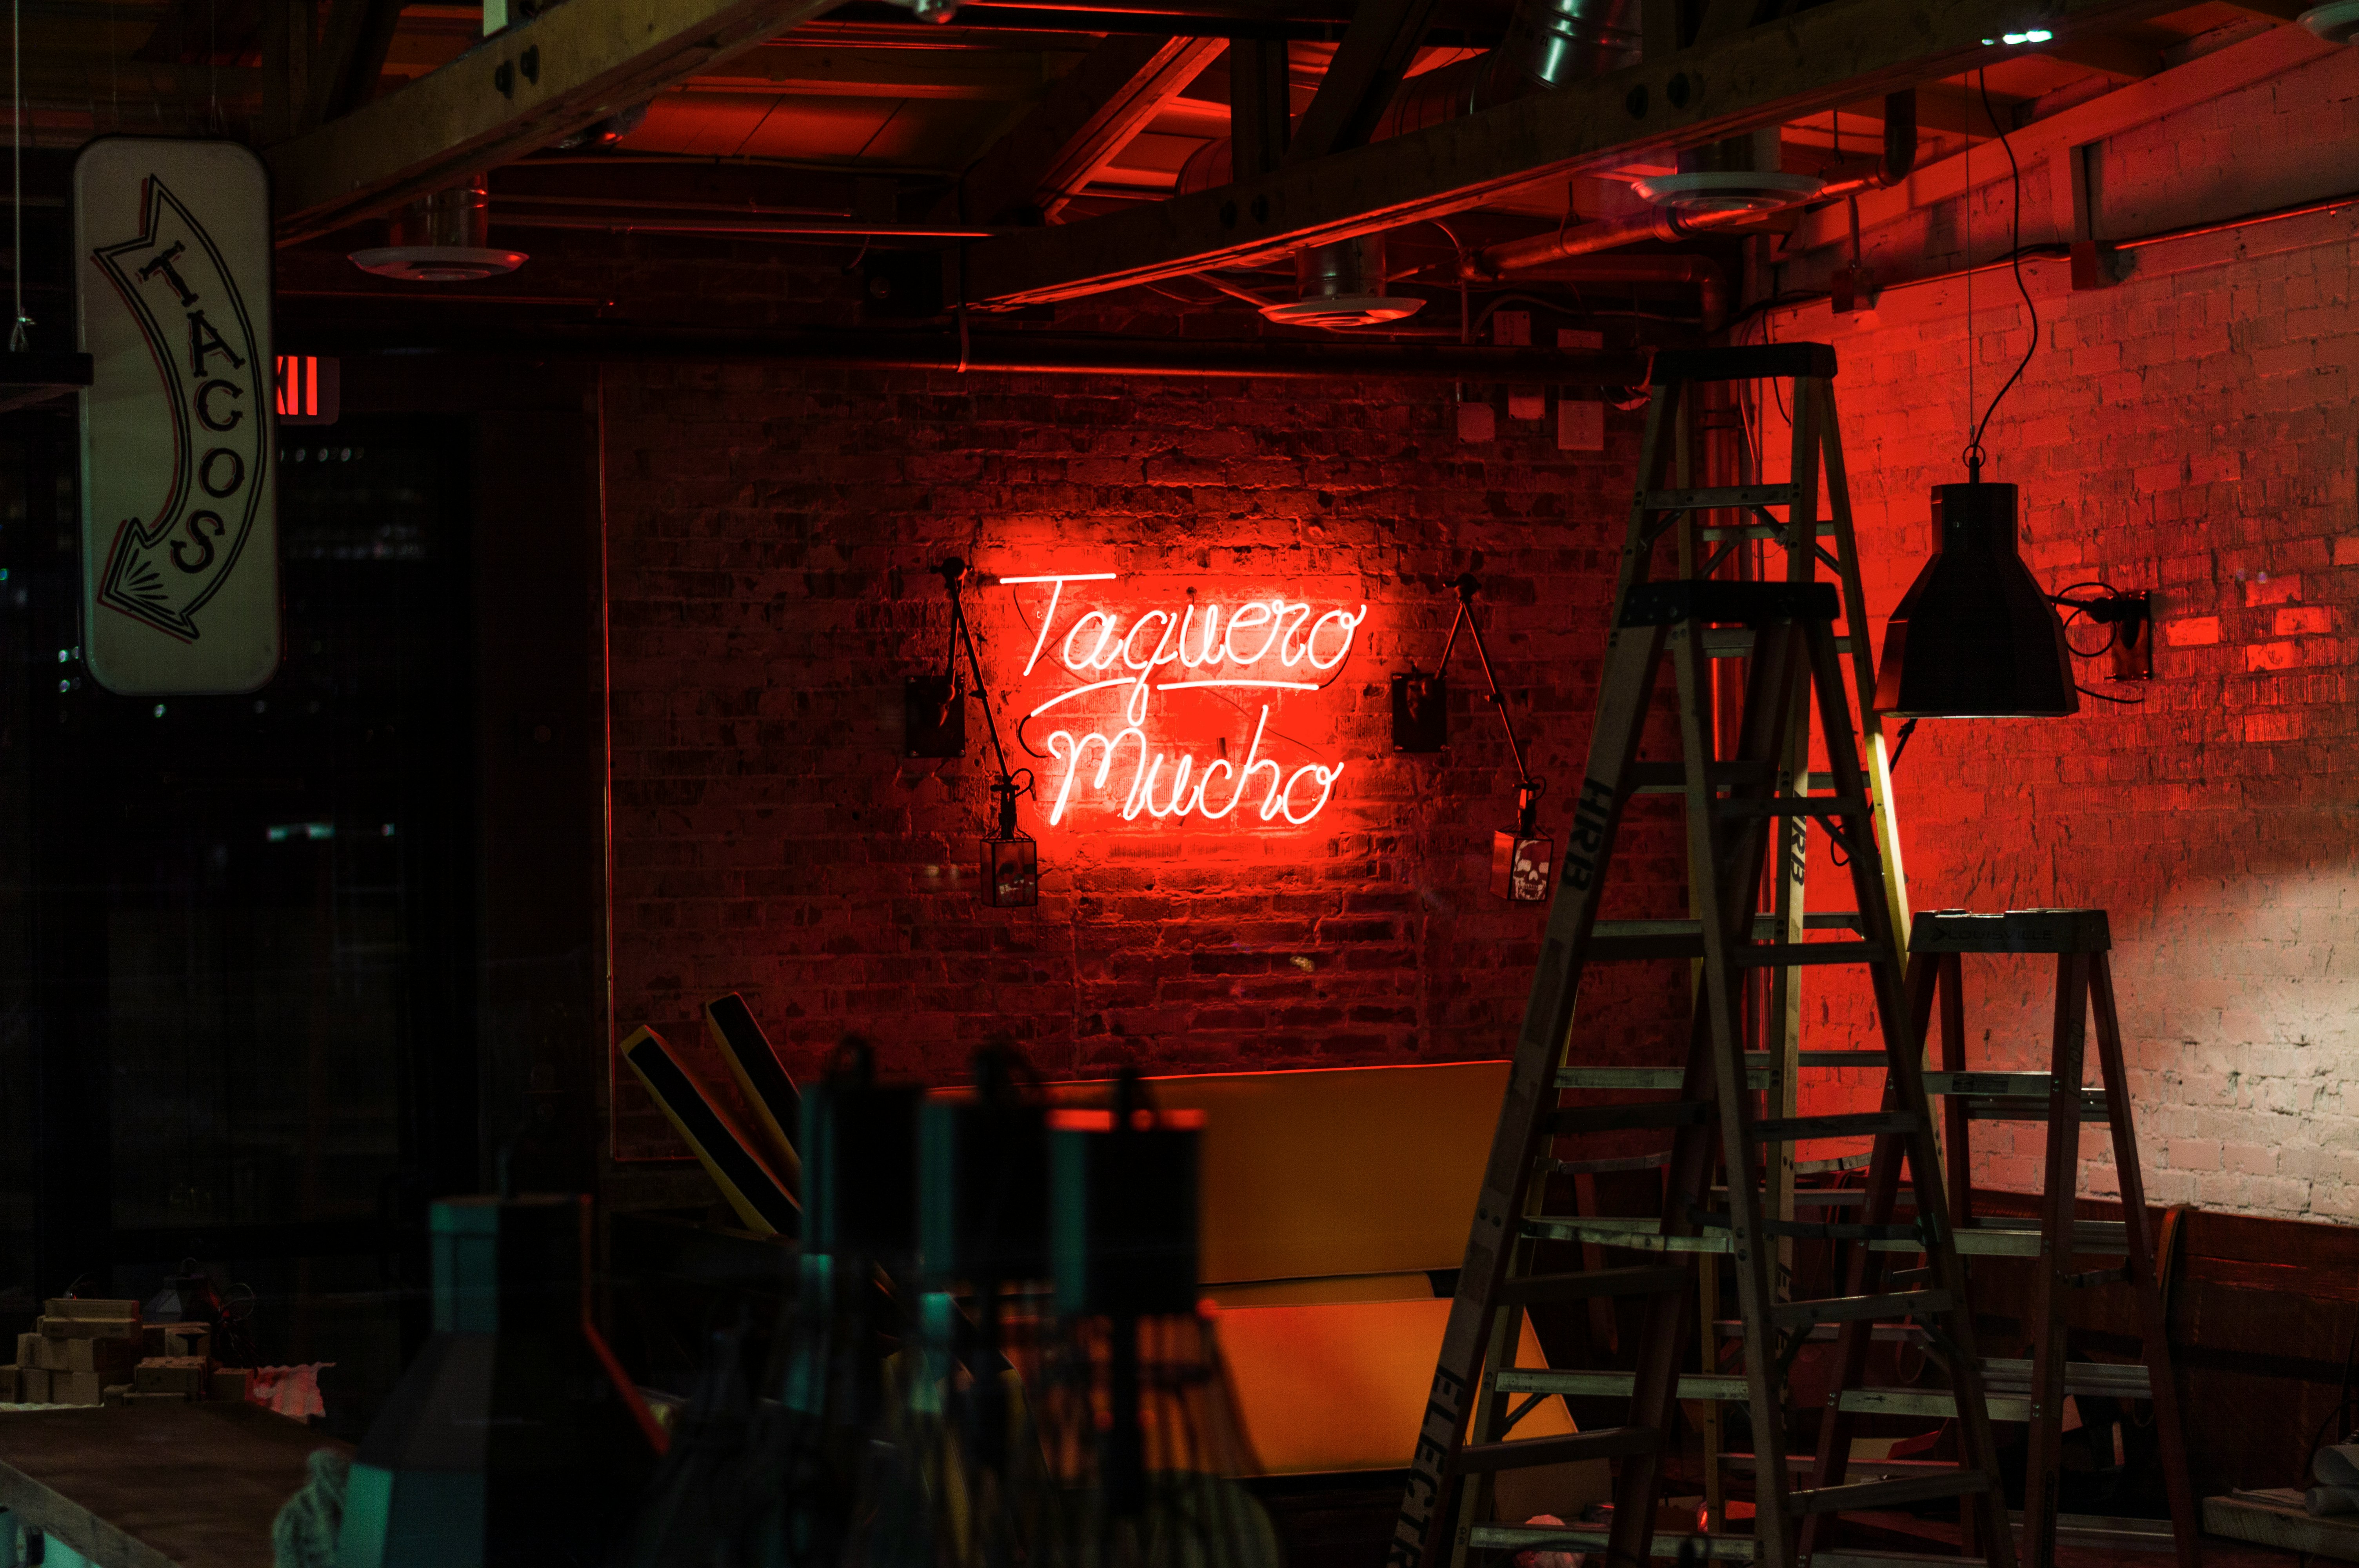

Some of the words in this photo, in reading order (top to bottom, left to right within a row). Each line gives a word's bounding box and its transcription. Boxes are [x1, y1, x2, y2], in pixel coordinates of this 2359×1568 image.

[138, 240, 245, 573] TACOS
[1000, 572, 1368, 727] Taquero
[1047, 704, 1345, 826] Mucho
[1562, 778, 1613, 890] HRB
[1948, 930, 2053, 941] LOUISVILLE
